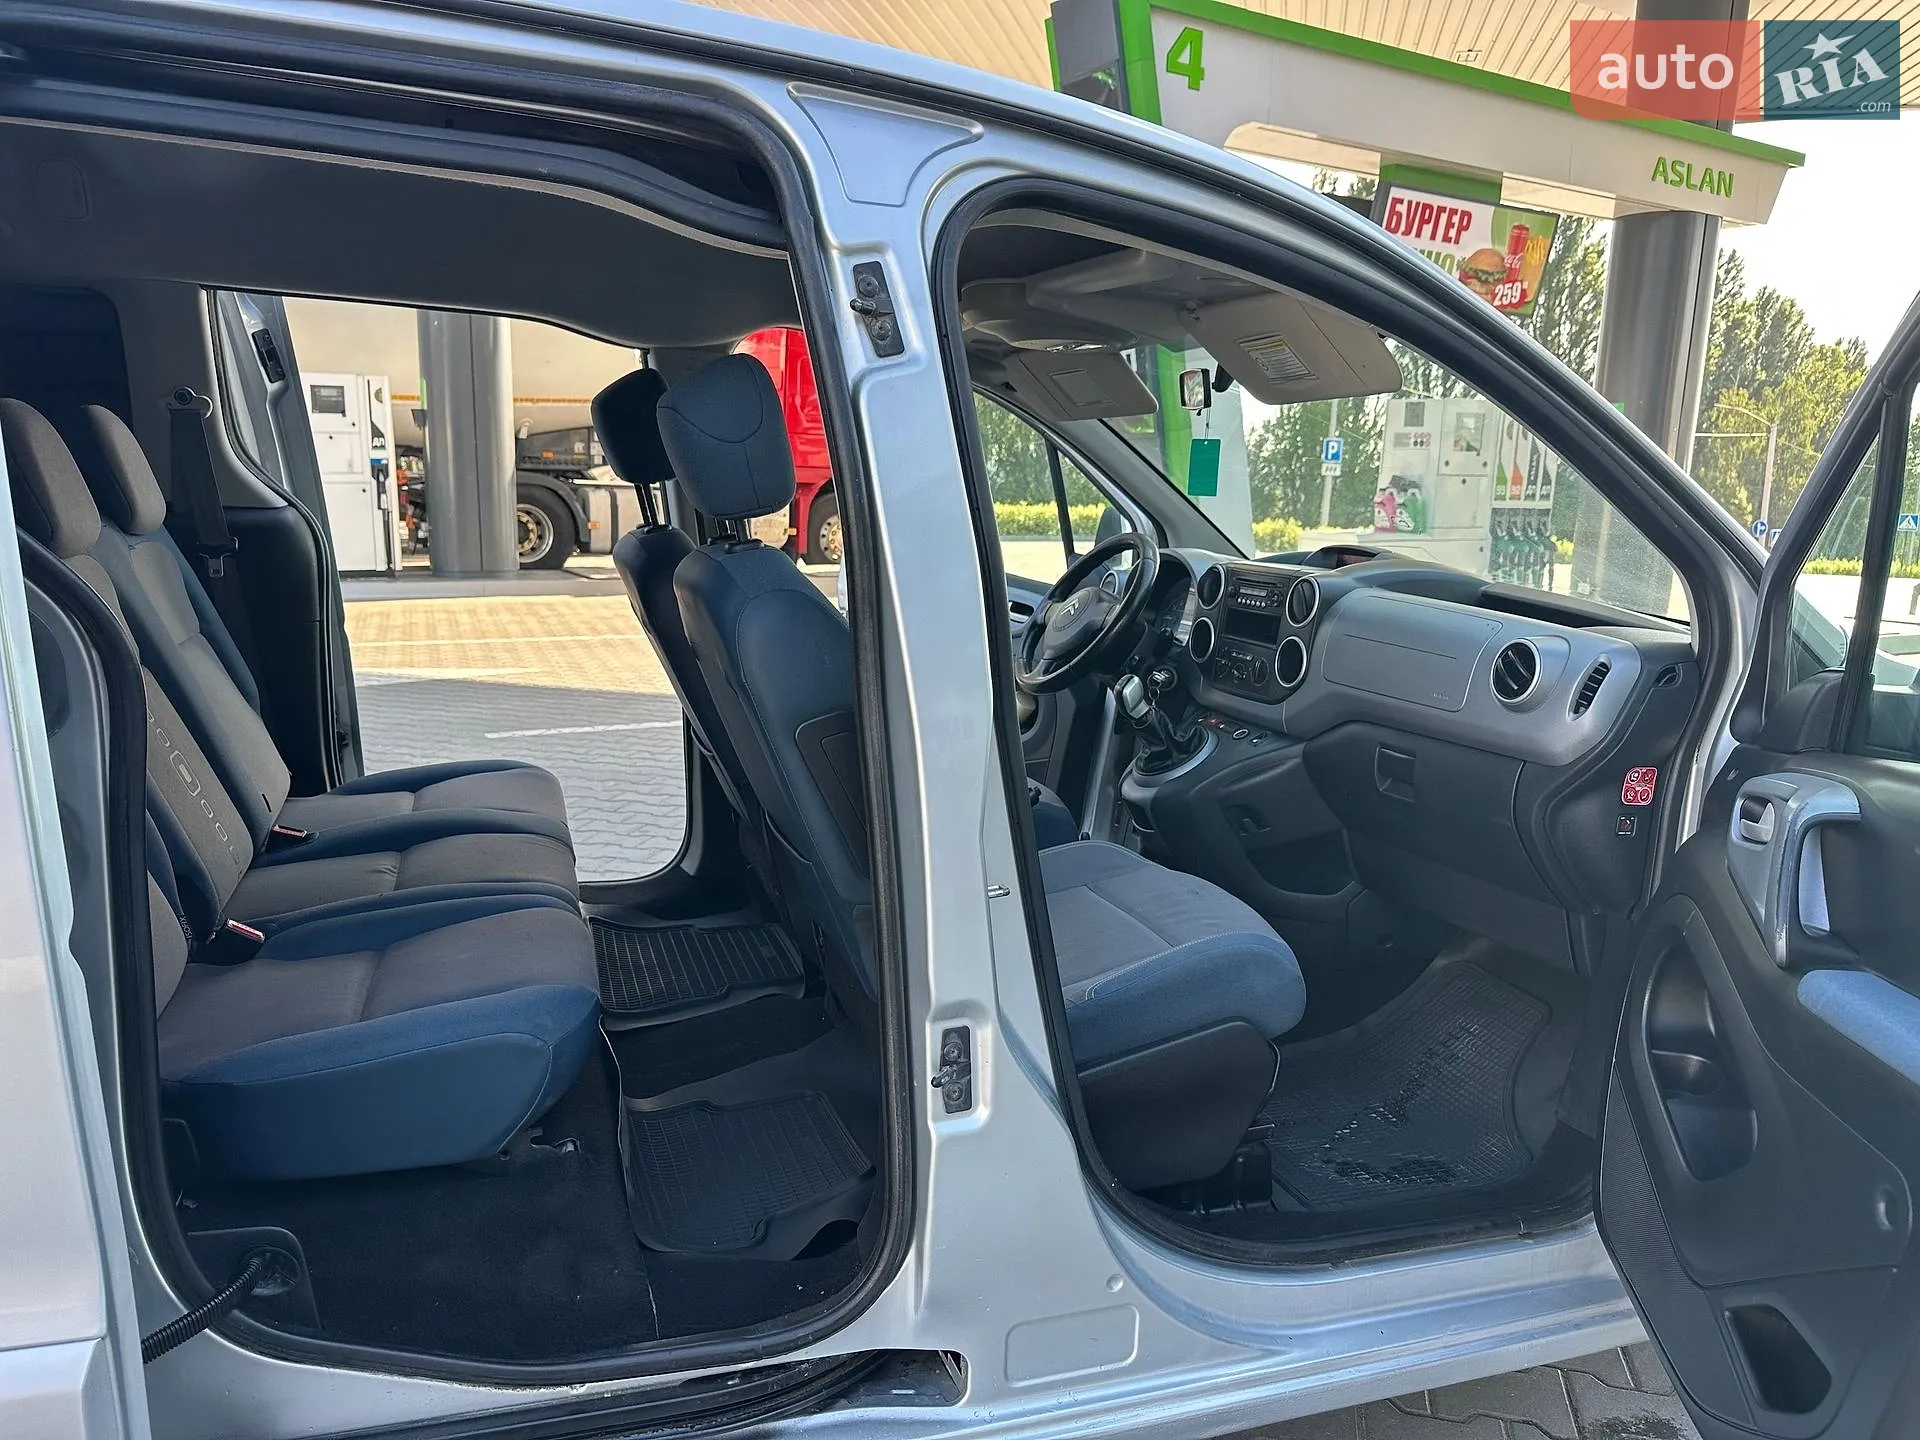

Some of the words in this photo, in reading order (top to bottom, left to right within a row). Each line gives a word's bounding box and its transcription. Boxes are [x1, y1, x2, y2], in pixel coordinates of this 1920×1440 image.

[1166, 26, 1205, 91] 4
[1651, 156, 1734, 198] ASLAN
[1384, 197, 1473, 245] БУРГЕР
[1493, 281, 1521, 306] 259
